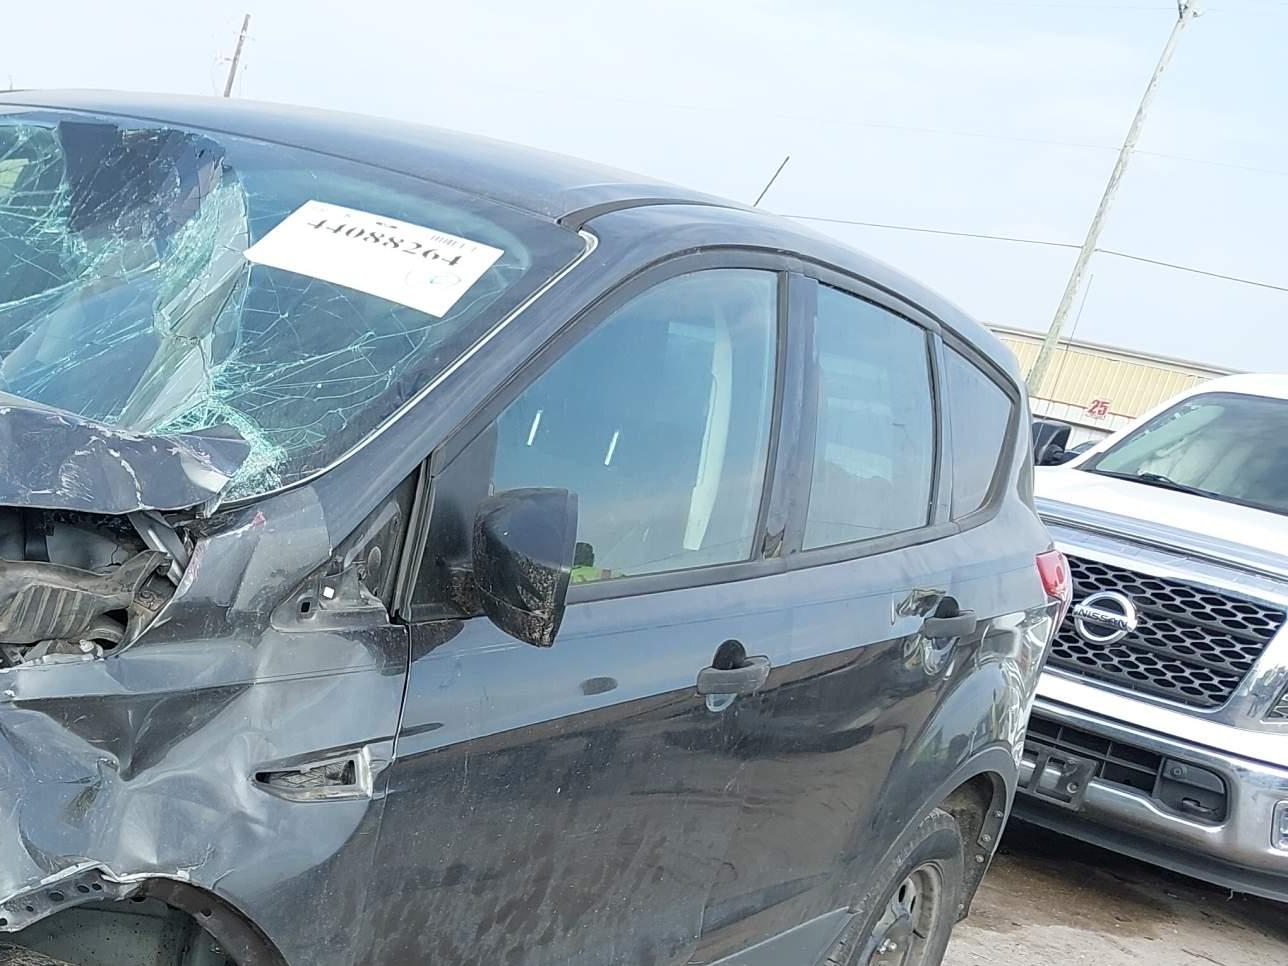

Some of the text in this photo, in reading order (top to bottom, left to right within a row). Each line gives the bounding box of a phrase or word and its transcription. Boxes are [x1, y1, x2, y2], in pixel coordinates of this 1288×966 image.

[308, 219, 462, 266] 44088264
[1088, 399, 1110, 415] 25
[1078, 608, 1128, 628] NISSAN
